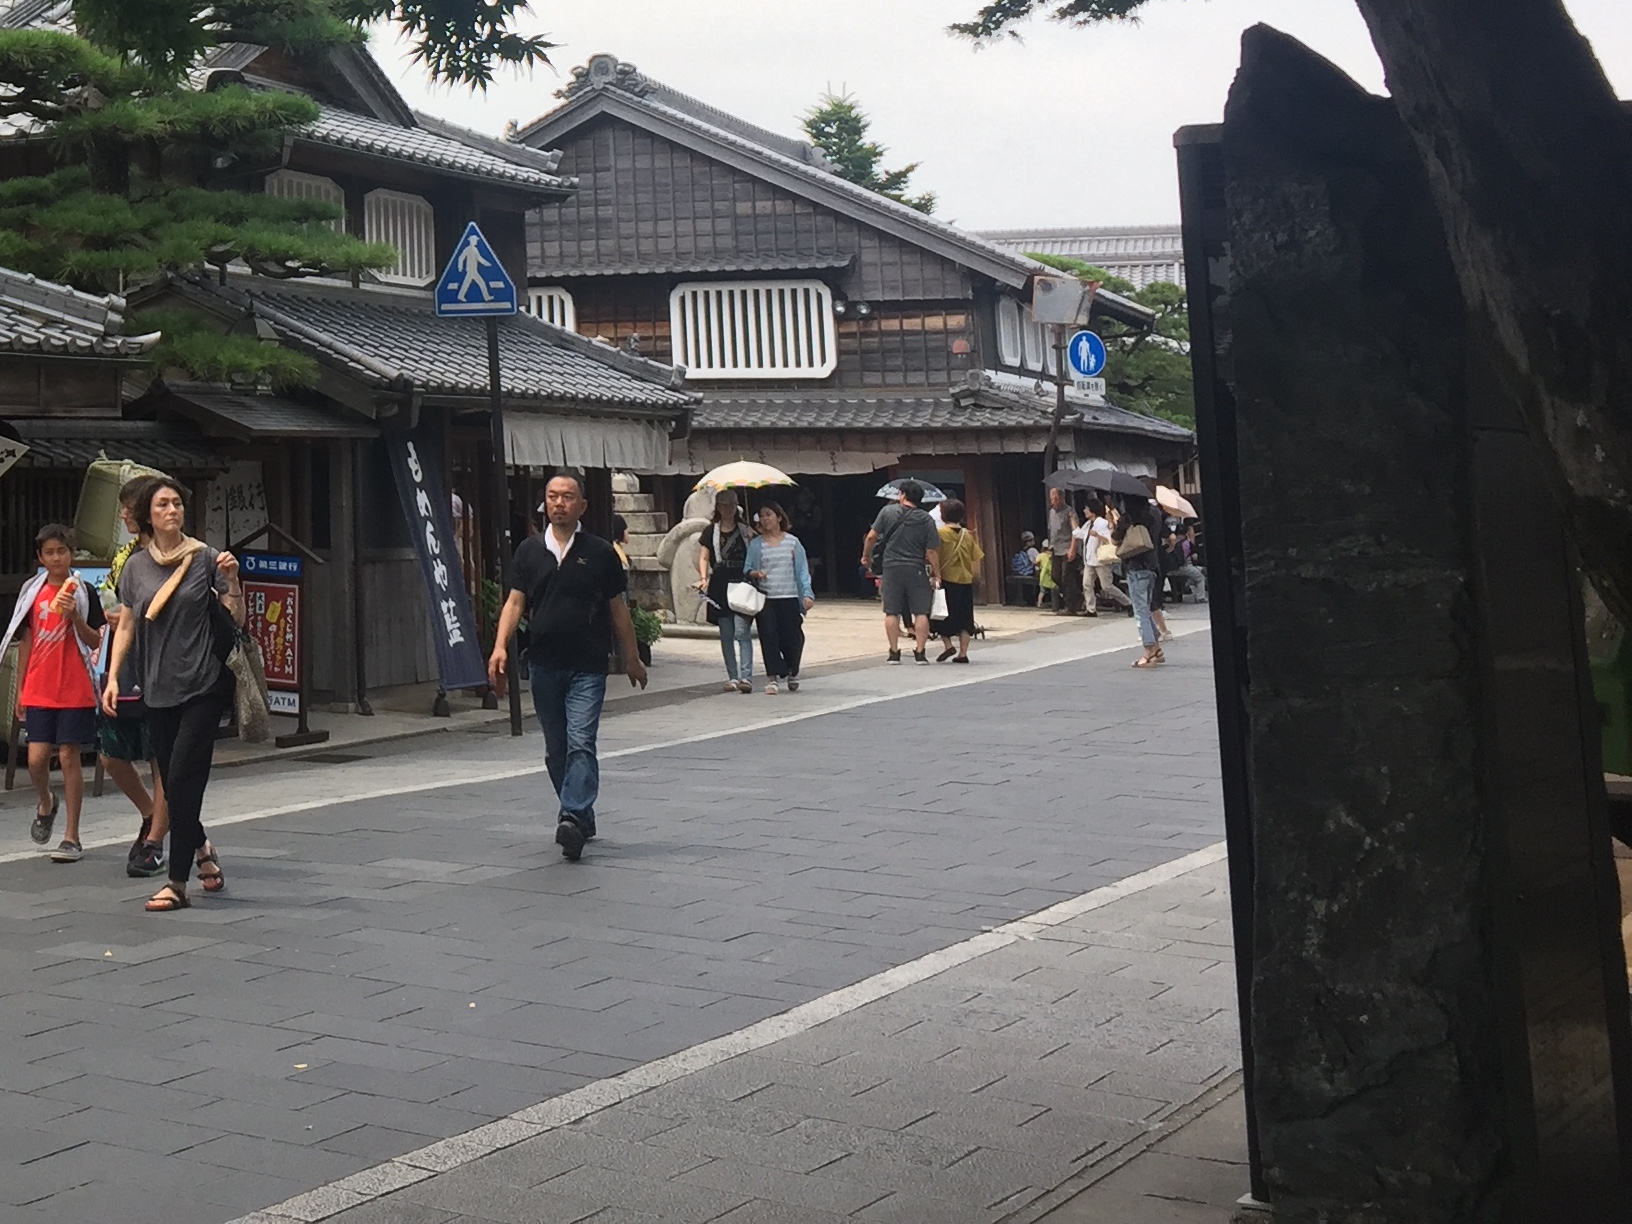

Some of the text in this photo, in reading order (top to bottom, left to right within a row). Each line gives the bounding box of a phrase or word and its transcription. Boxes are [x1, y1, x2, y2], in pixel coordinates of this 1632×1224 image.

[407, 441, 465, 647] もめんや藍
